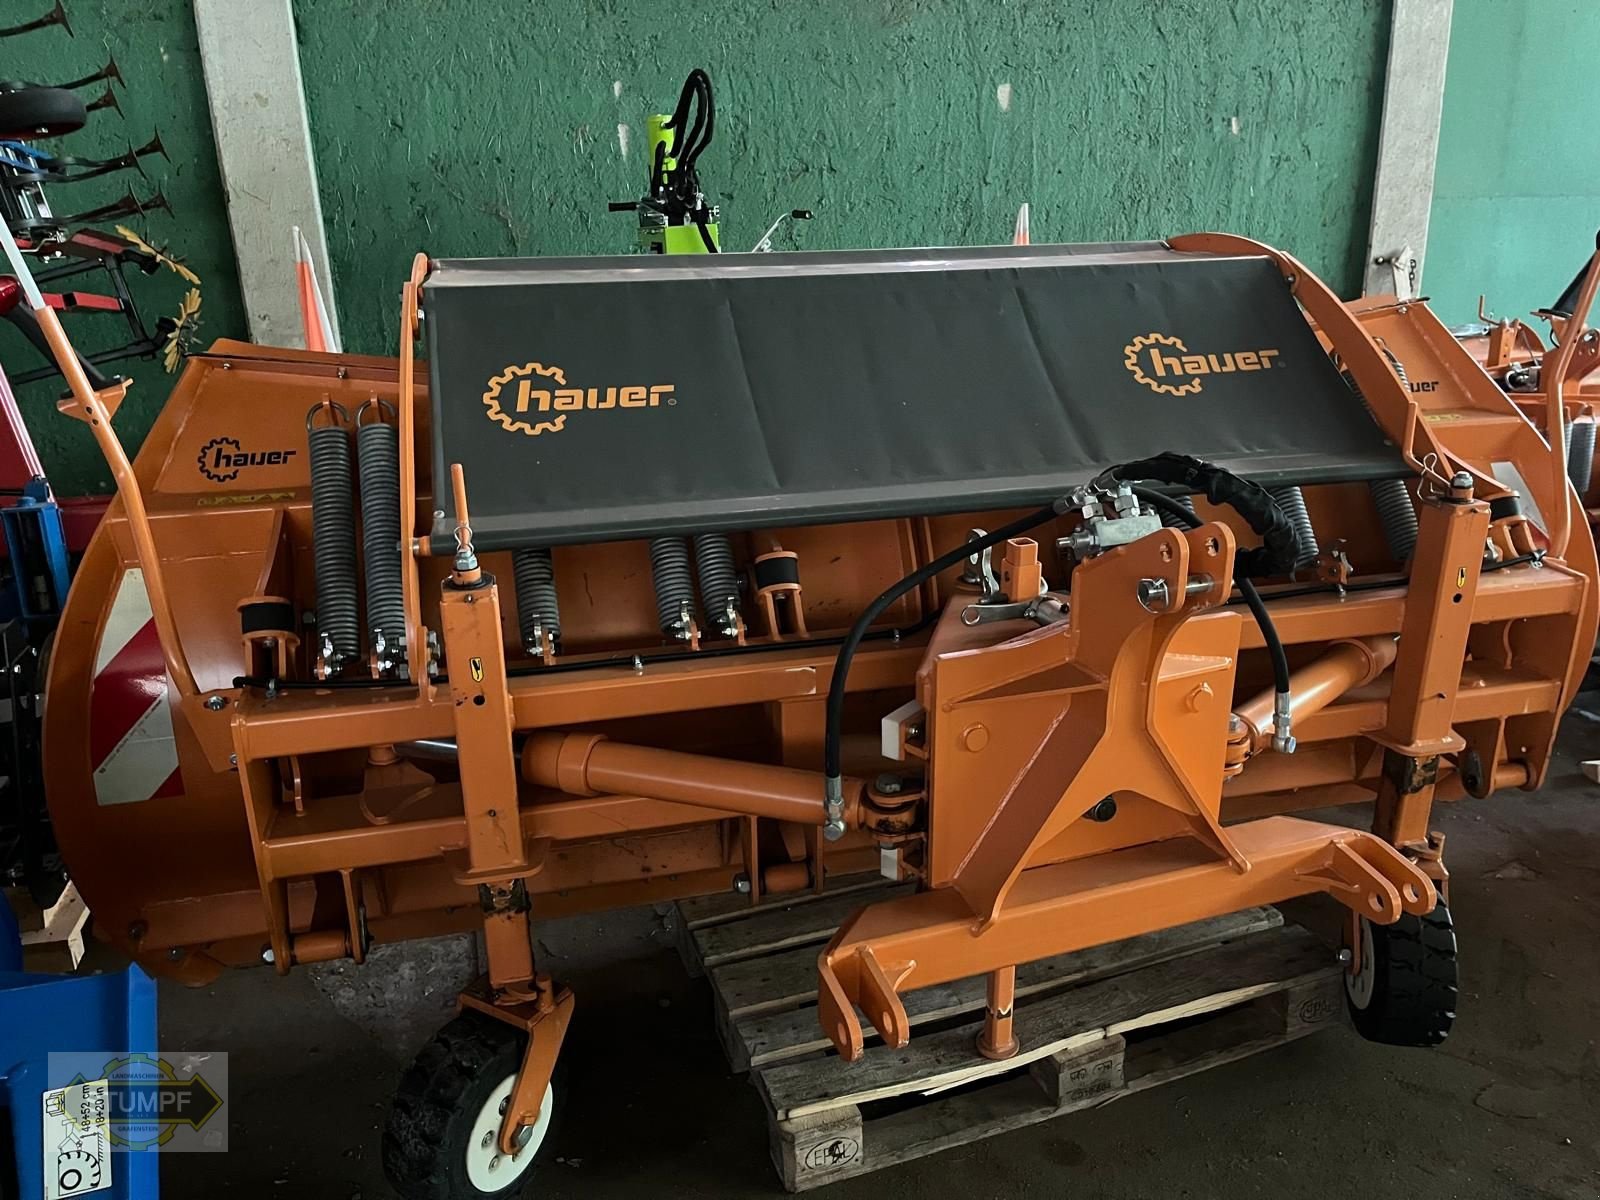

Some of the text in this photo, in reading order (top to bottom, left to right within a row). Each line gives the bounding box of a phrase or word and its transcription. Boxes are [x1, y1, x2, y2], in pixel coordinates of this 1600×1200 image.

[1150, 348, 1279, 377] hauer
[516, 379, 675, 412] hauer
[1410, 381, 1439, 393] uer
[214, 447, 297, 469] hauer
[82, 1084, 91, 1100] cm
[94, 1086, 105, 1097] in
[814, 1143, 851, 1167] EPAL
